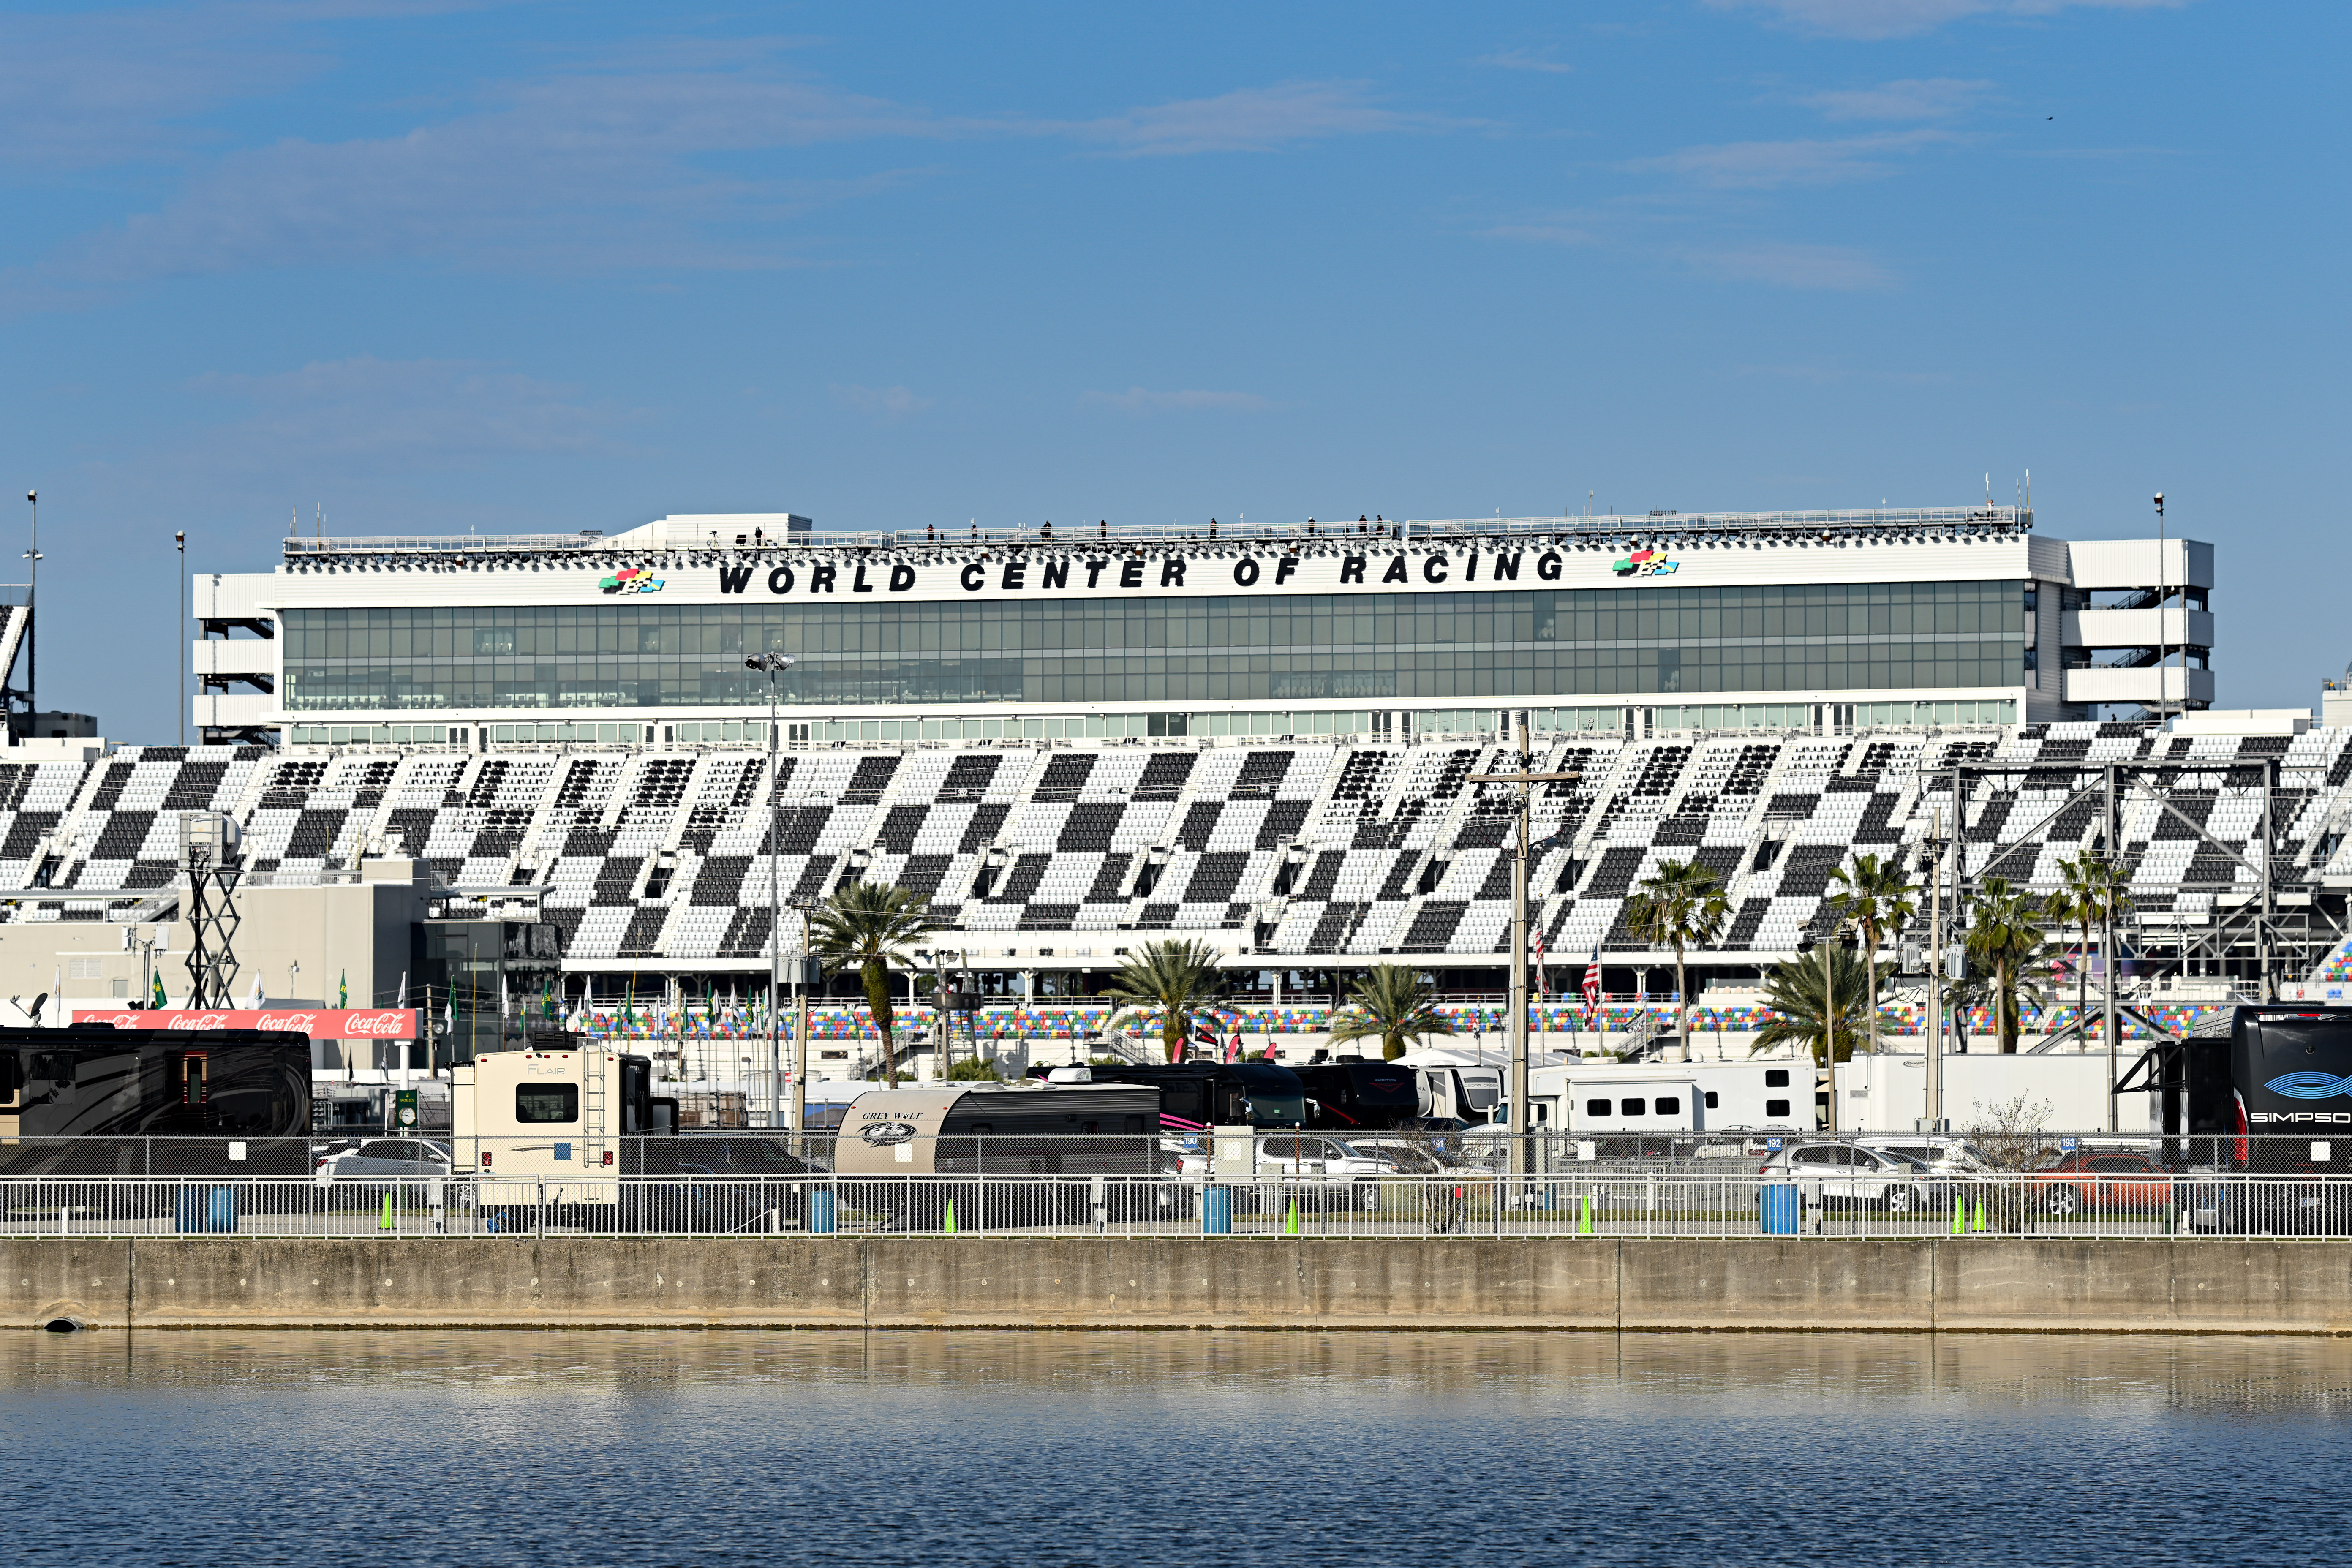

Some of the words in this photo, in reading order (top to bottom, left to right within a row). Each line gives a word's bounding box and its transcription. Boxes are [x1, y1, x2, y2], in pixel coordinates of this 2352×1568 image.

[719, 564, 916, 594] WORLD
[961, 559, 1186, 591] CENTER
[1233, 557, 1299, 586] OF
[1340, 552, 1562, 584] RACING
[256, 1013, 317, 1034] Coca-Cola
[344, 1013, 406, 1034] Coca-Cola
[1768, 1139, 1781, 1148] 192
[2062, 1138, 2075, 1147] 193
